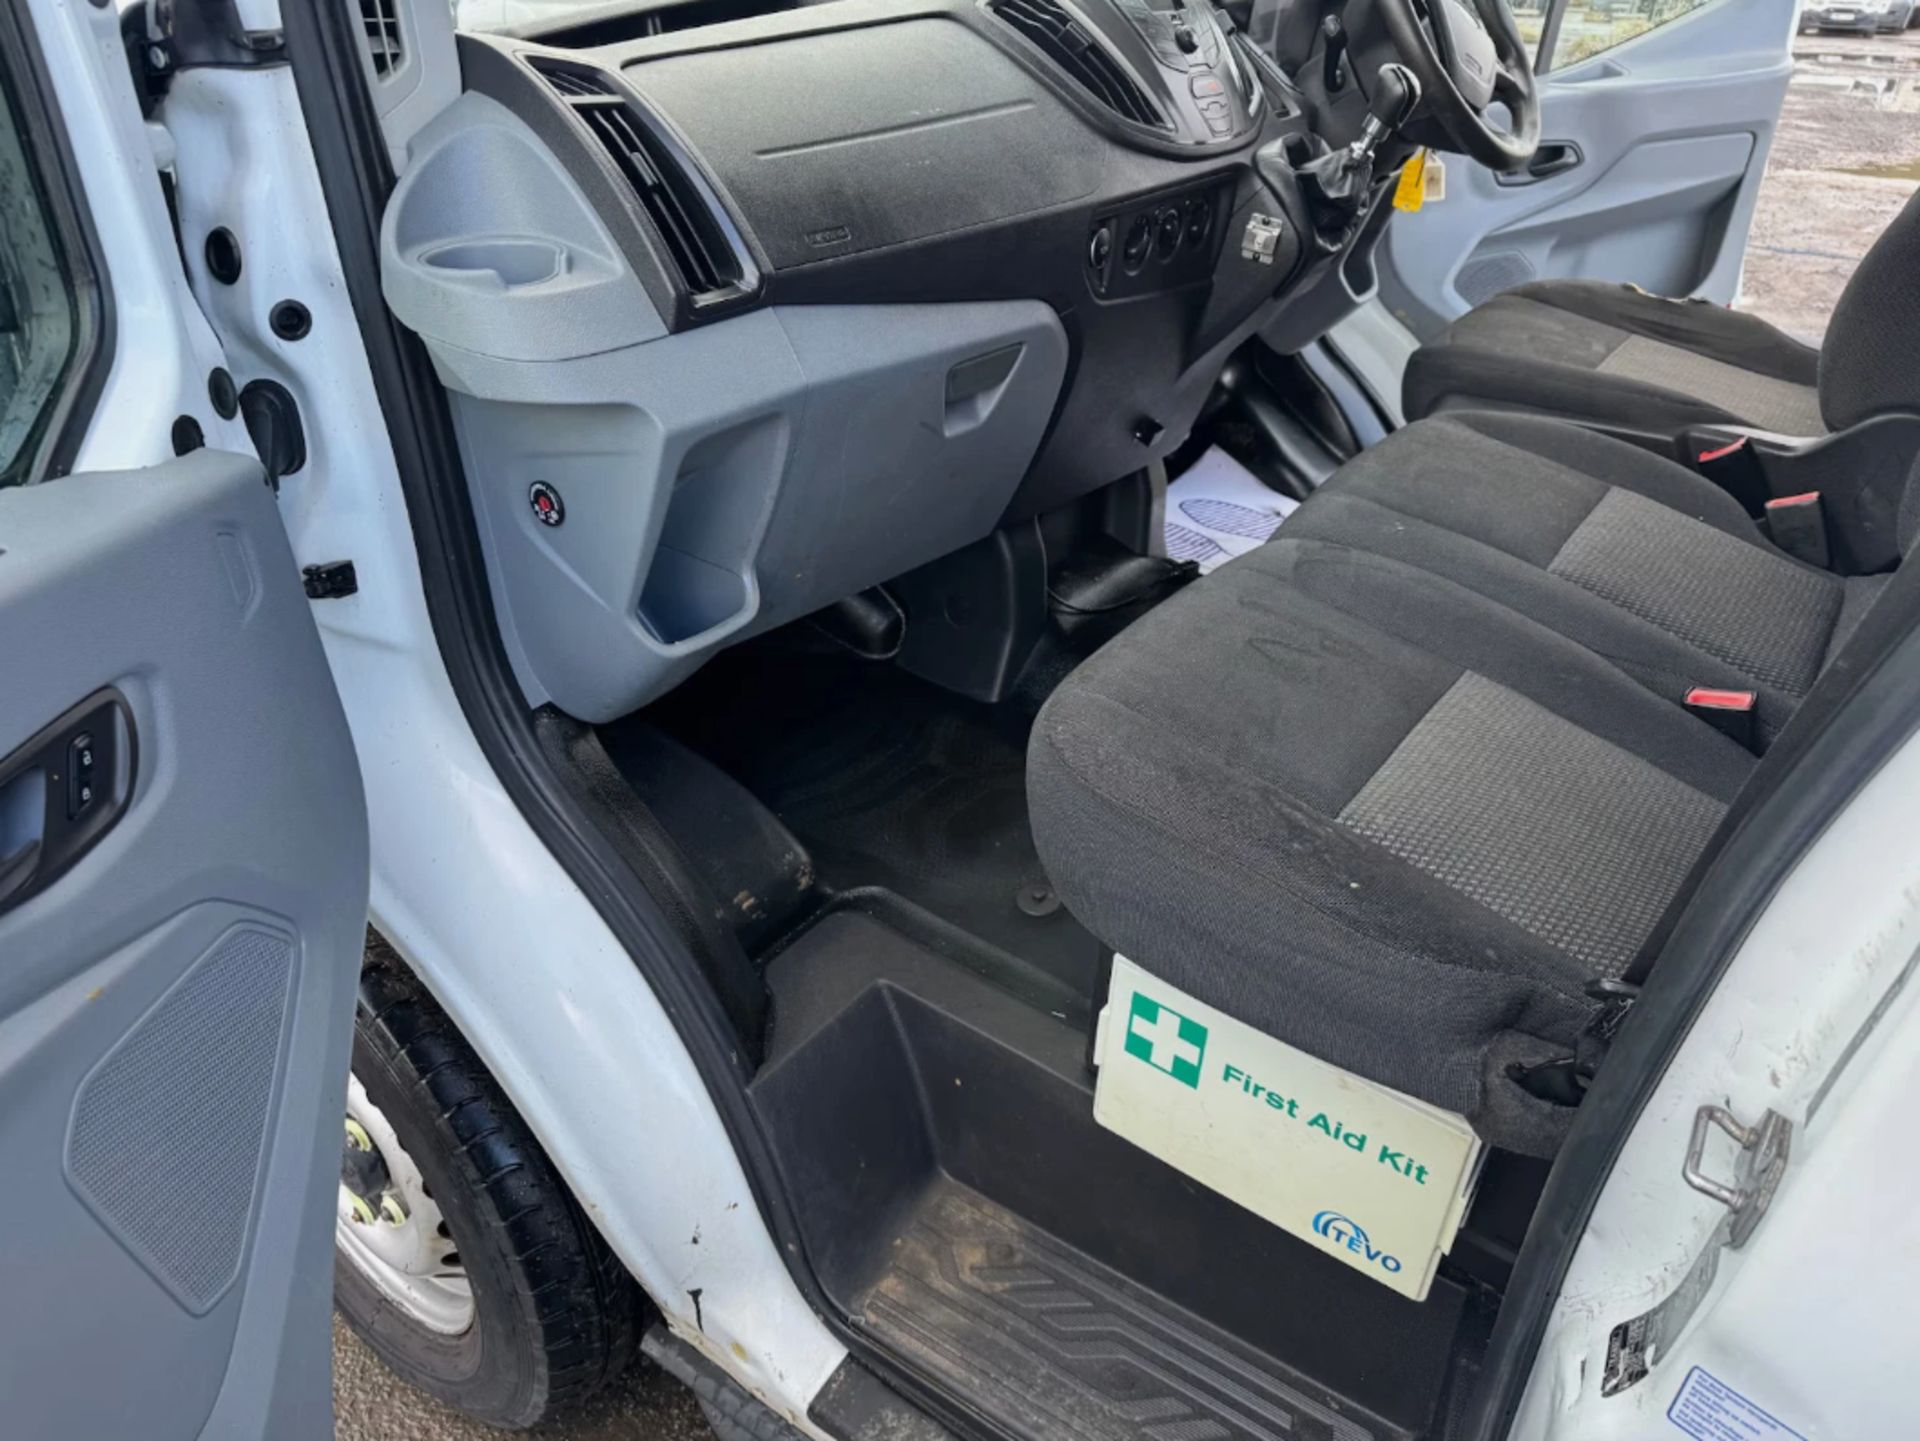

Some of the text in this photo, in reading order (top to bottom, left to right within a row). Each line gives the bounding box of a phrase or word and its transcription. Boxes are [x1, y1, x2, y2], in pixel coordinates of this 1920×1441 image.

[1222, 1064, 1429, 1185] First Aid Kit
[1331, 1226, 1401, 1273] TEVO
